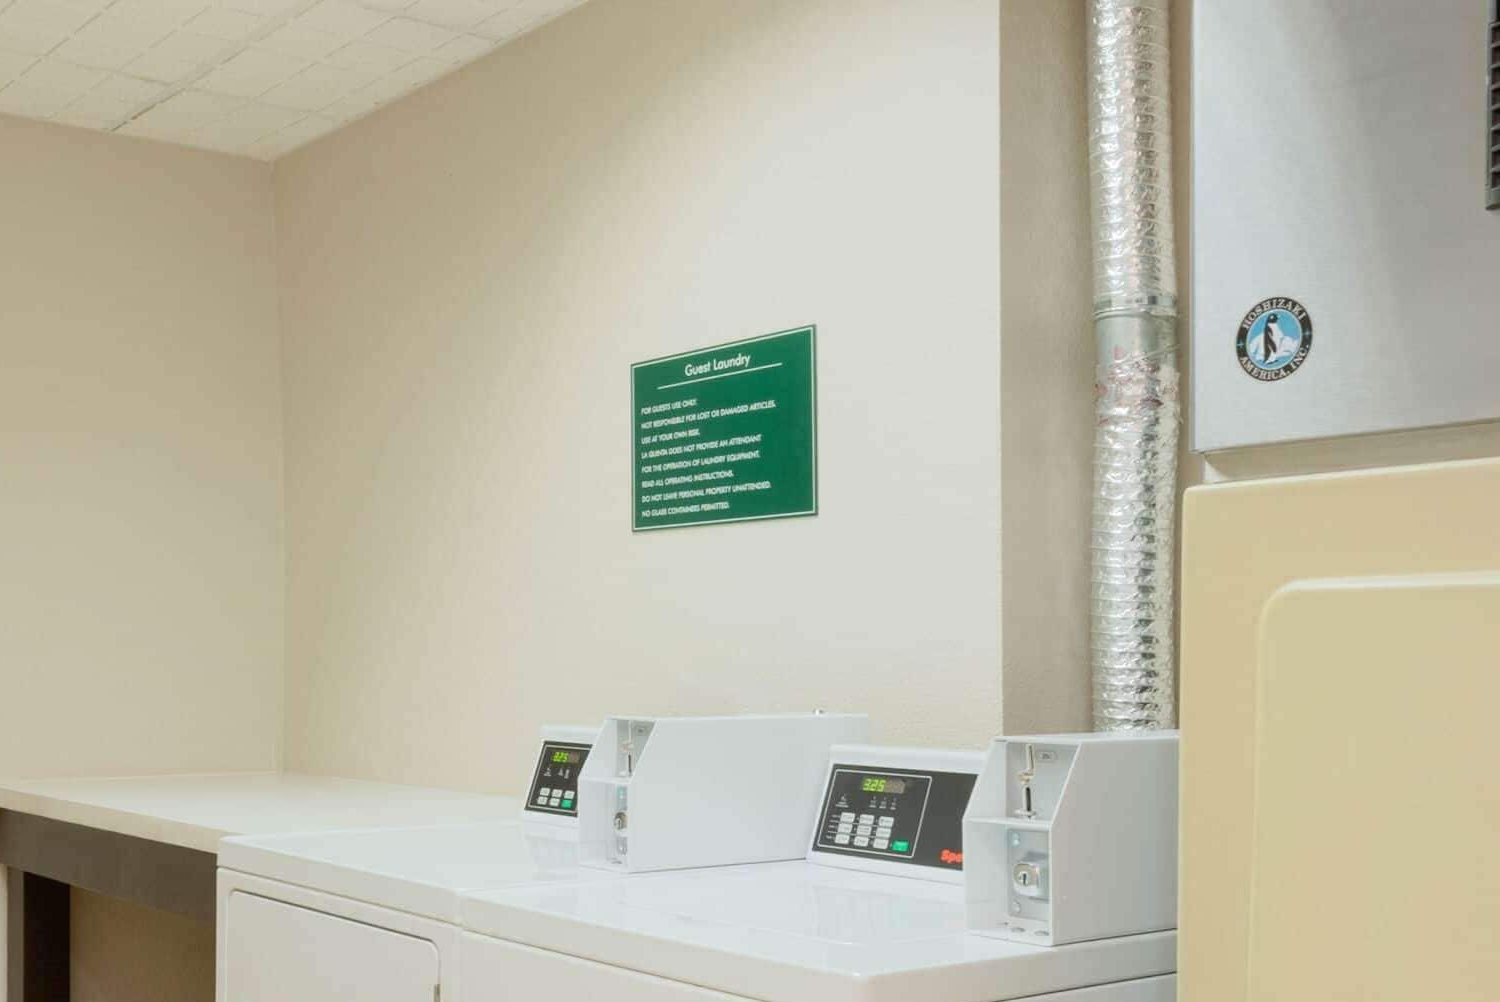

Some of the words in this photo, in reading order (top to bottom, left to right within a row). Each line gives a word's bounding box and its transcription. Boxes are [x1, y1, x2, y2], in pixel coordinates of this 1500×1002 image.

[1243, 299, 1306, 329] HOSHIZAKI
[685, 361, 710, 376] Guest
[713, 353, 751, 368] Laundry
[641, 406, 651, 415] FOR
[672, 401, 681, 409] USE
[641, 421, 652, 429] NOT
[653, 416, 684, 427] RESPONSIBLE
[697, 412, 710, 420] LOST
[721, 405, 748, 416] DAMAGED
[659, 433, 673, 441] YOUR
[648, 448, 668, 457] QUINTA
[669, 446, 682, 454] DOES
[696, 440, 718, 450] PROVIDE
[729, 434, 762, 445] ATTENDANT
[663, 460, 691, 470] OPERATION
[701, 456, 725, 465] LAUNDRY
[642, 480, 654, 488] READ
[665, 475, 692, 485] OPERATING
[678, 489, 705, 499] PERSONAL
[706, 486, 731, 495] PROPERTY
[651, 508, 667, 517] GLASS
[668, 504, 700, 514] CONTAINERS
[940, 848, 963, 864] Spe
